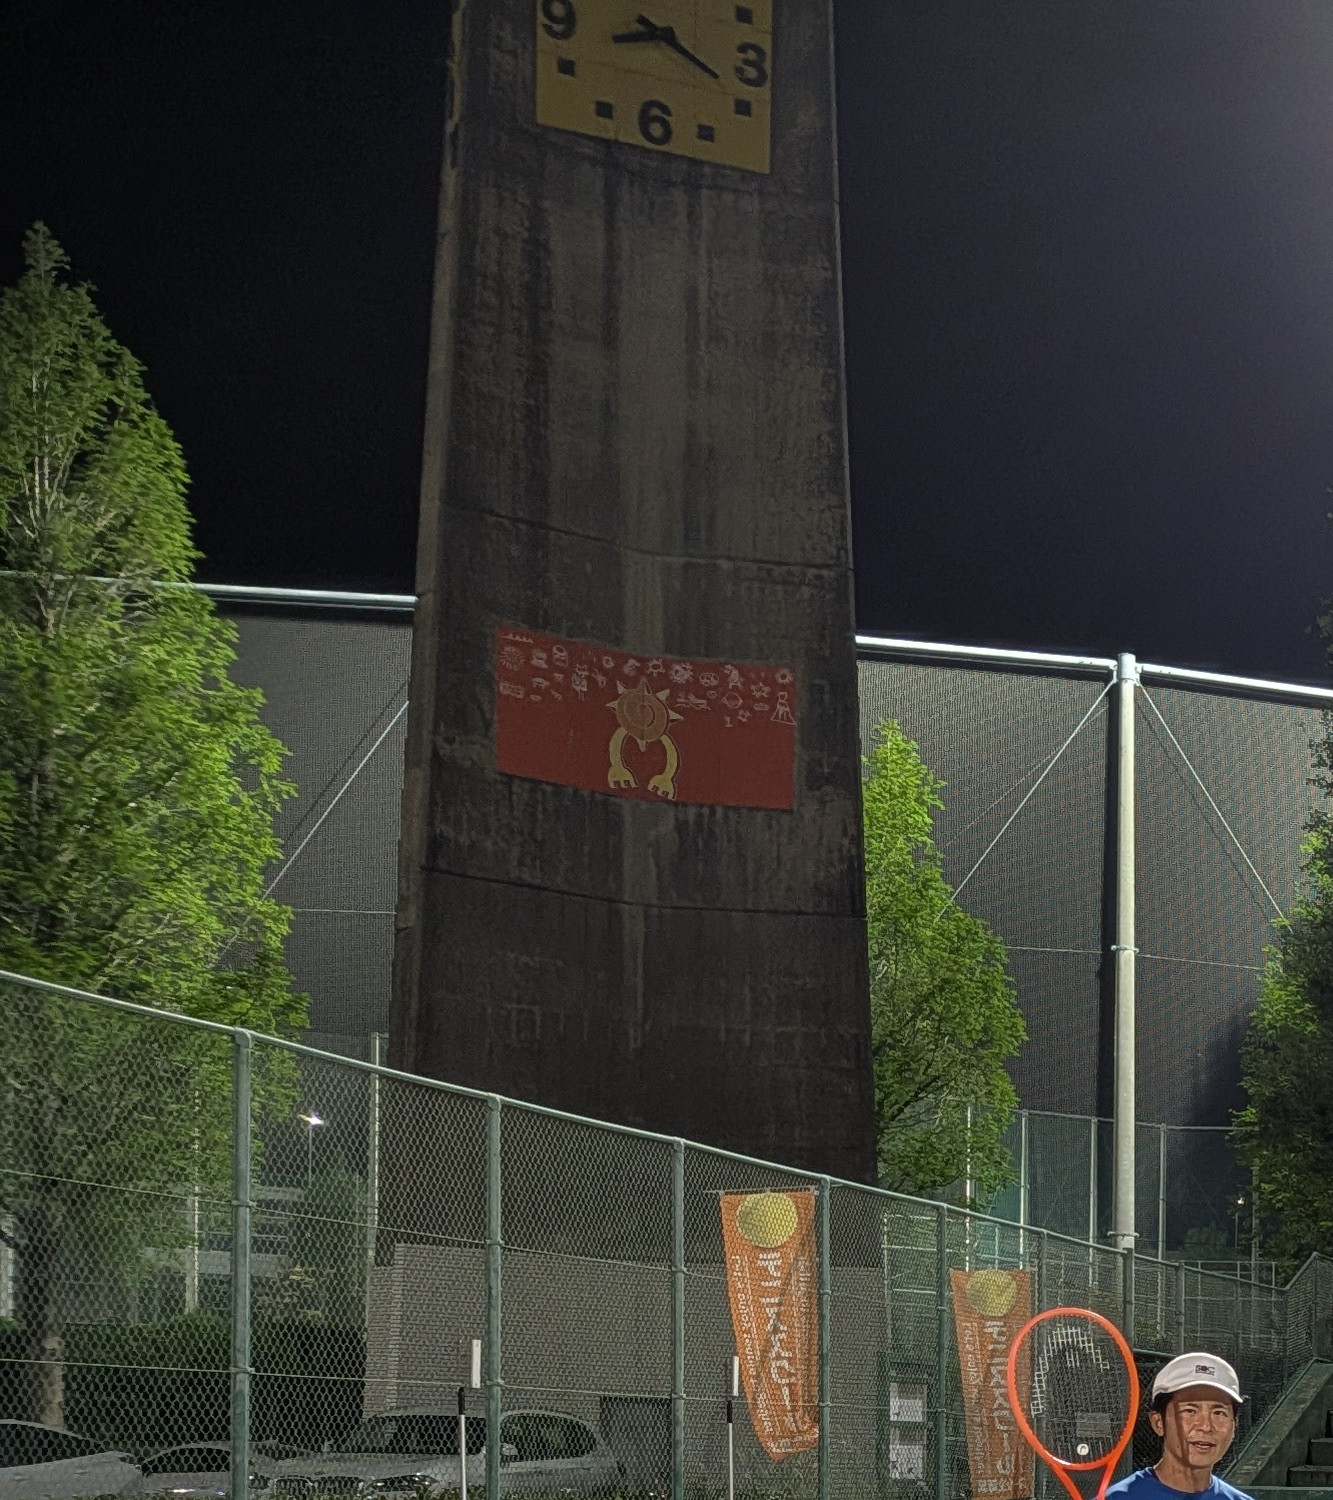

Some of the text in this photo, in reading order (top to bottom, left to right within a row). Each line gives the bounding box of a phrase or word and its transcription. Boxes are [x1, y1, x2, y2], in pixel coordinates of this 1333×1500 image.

[541, 0, 578, 40] 9
[735, 42, 769, 88] 3
[638, 100, 673, 145] 6
